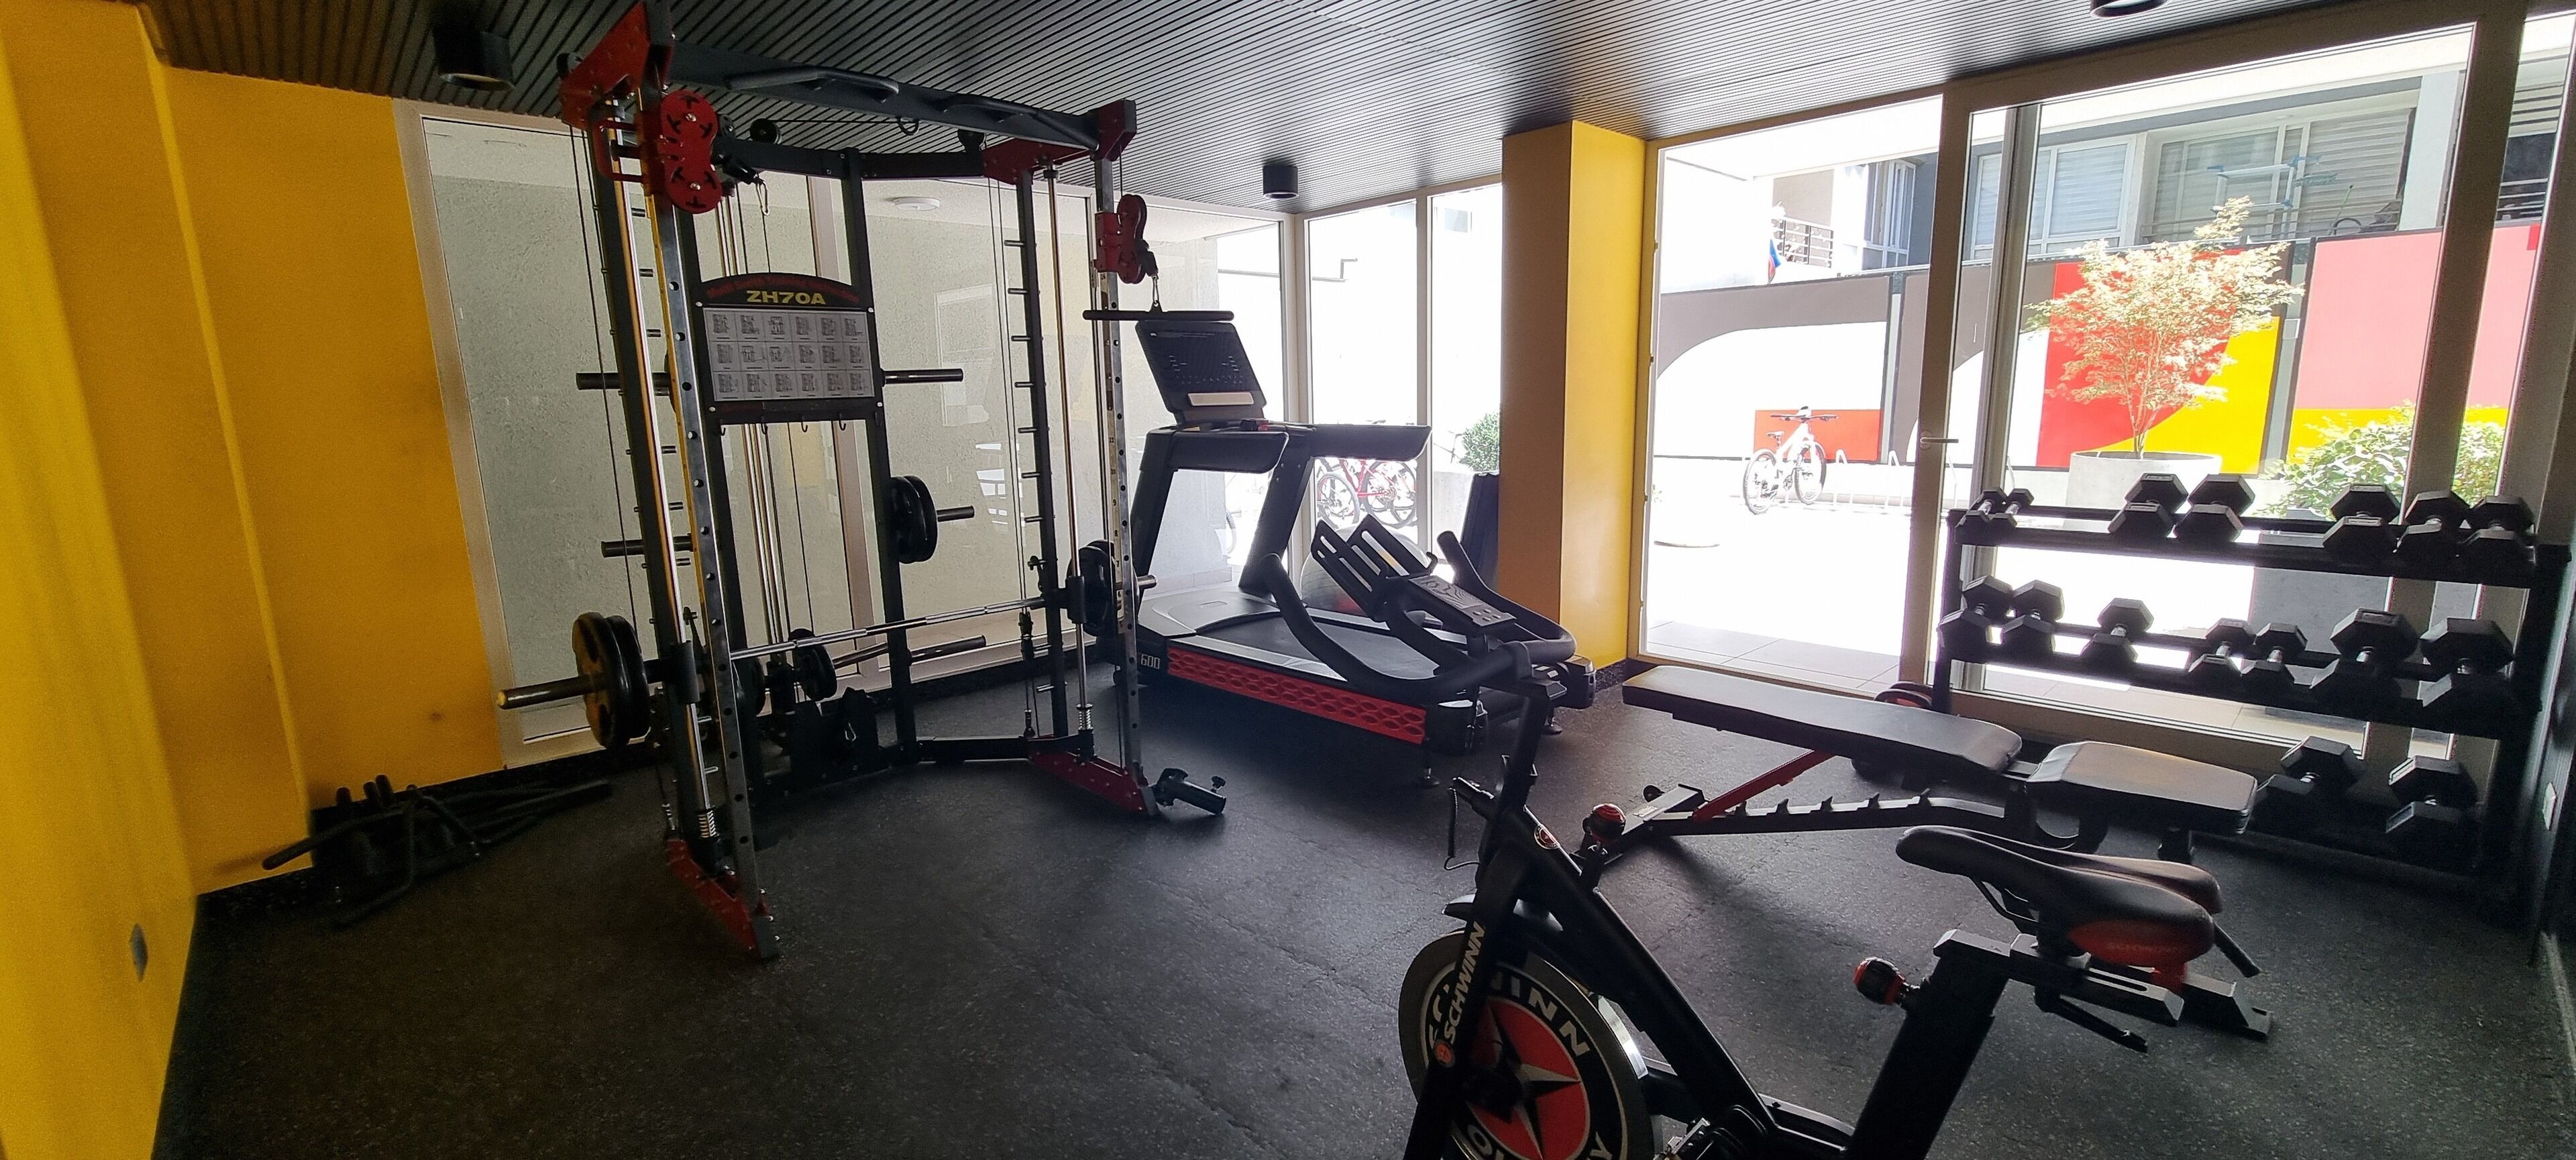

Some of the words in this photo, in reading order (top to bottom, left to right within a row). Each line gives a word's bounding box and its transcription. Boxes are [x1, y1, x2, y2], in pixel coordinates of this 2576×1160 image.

[746, 290, 825, 305] ZH70A
[1140, 653, 1160, 669] 600
[1445, 921, 1485, 1044] SCHWINN
